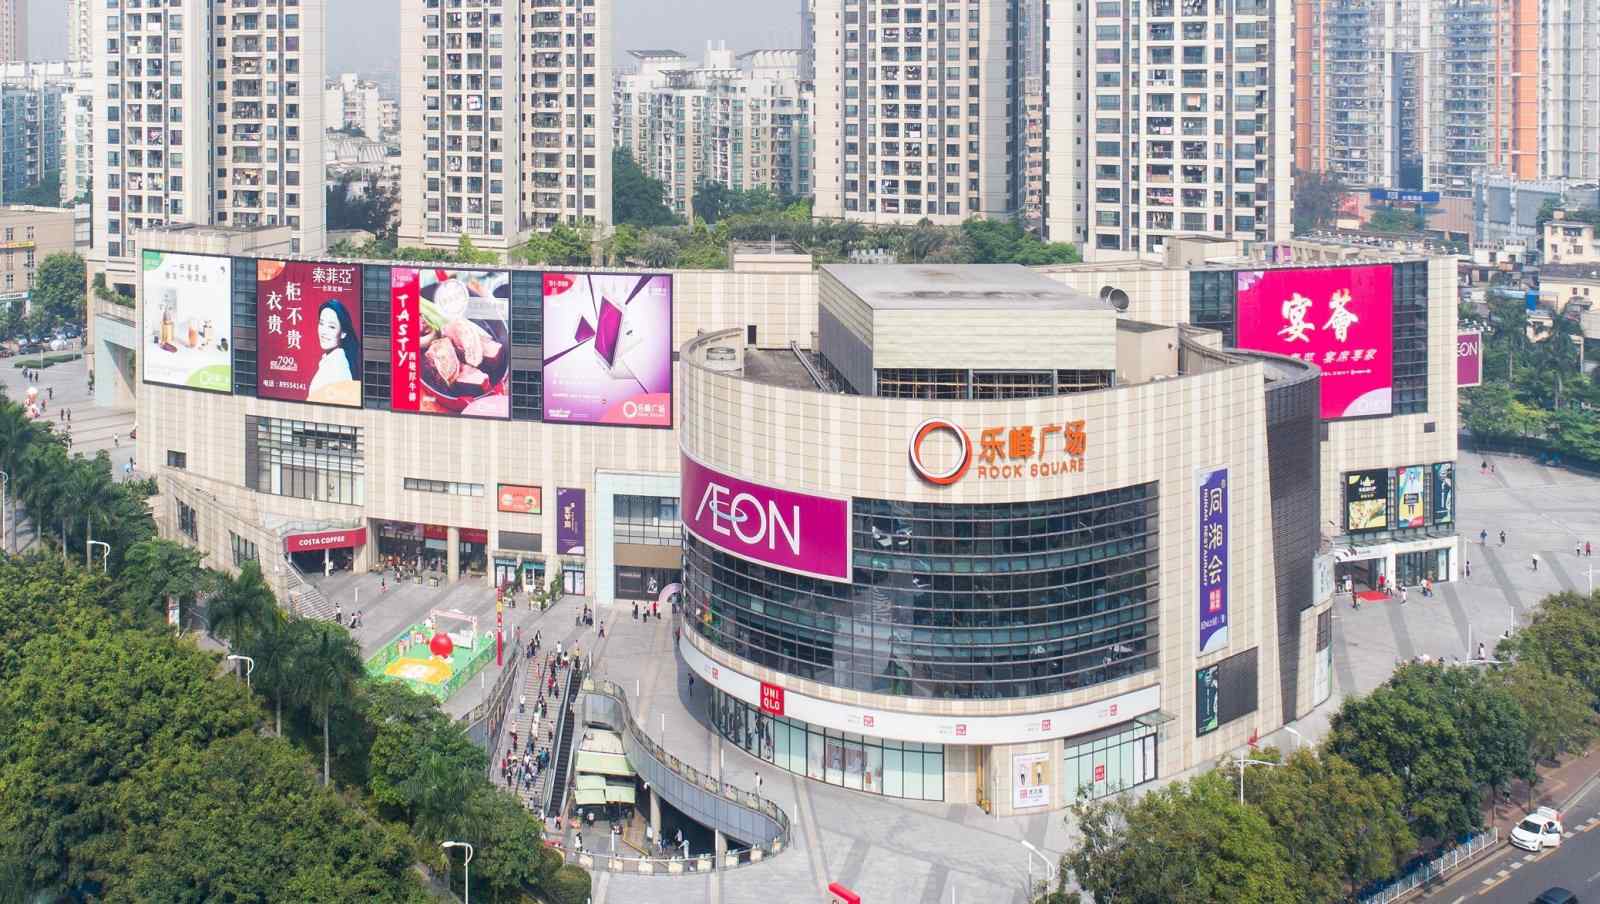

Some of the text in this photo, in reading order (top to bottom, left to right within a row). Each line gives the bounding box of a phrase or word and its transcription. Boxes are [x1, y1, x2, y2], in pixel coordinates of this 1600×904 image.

[266, 291, 283, 334] 衣贵
[286, 281, 304, 349] 柜不贵
[396, 293, 409, 367] TASTY
[978, 419, 1086, 466] 乐峰广场
[977, 458, 1085, 480] ROCK SQUARE
[298, 535, 345, 546] COSTA COFFEE
[763, 687, 779, 700] UNI
[763, 697, 780, 711] QLO
